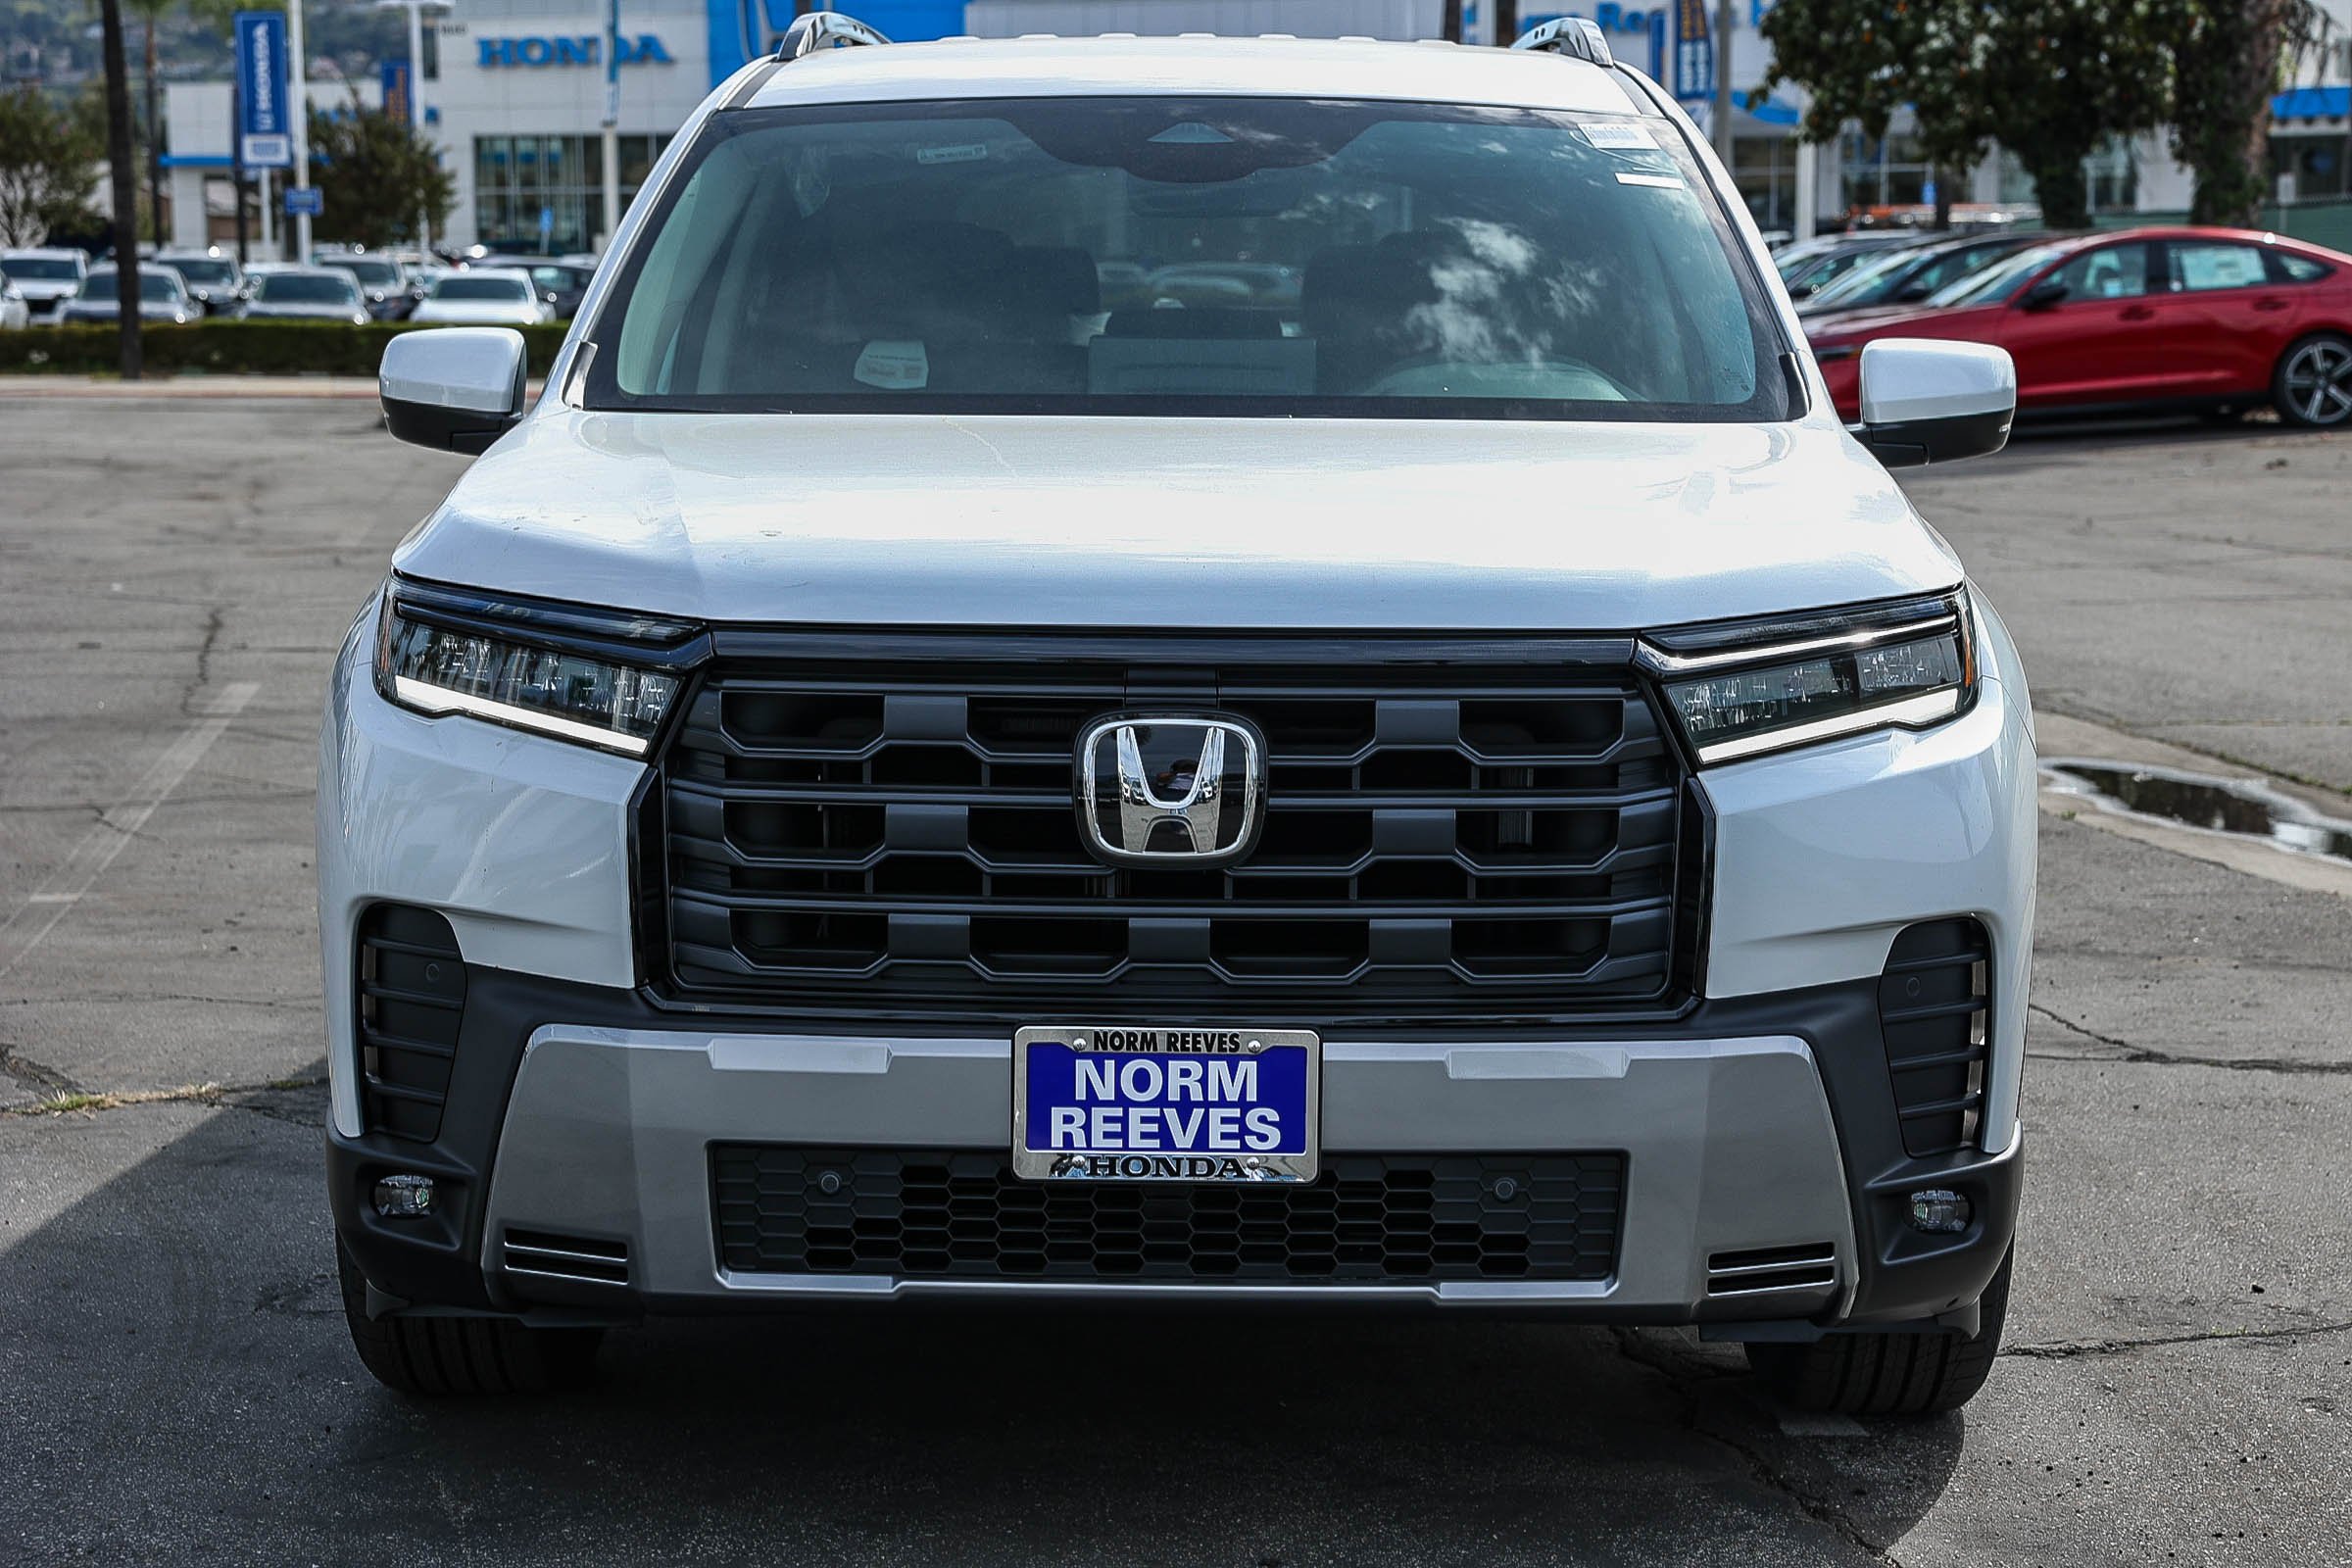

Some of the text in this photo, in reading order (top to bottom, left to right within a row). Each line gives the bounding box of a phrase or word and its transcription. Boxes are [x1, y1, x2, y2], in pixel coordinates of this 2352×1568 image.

[1093, 1031, 1240, 1054] NORM REEVES
[1075, 1059, 1257, 1102] NORM
[1051, 1107, 1282, 1150] REEVES
[1084, 1155, 1251, 1178] HONDA
